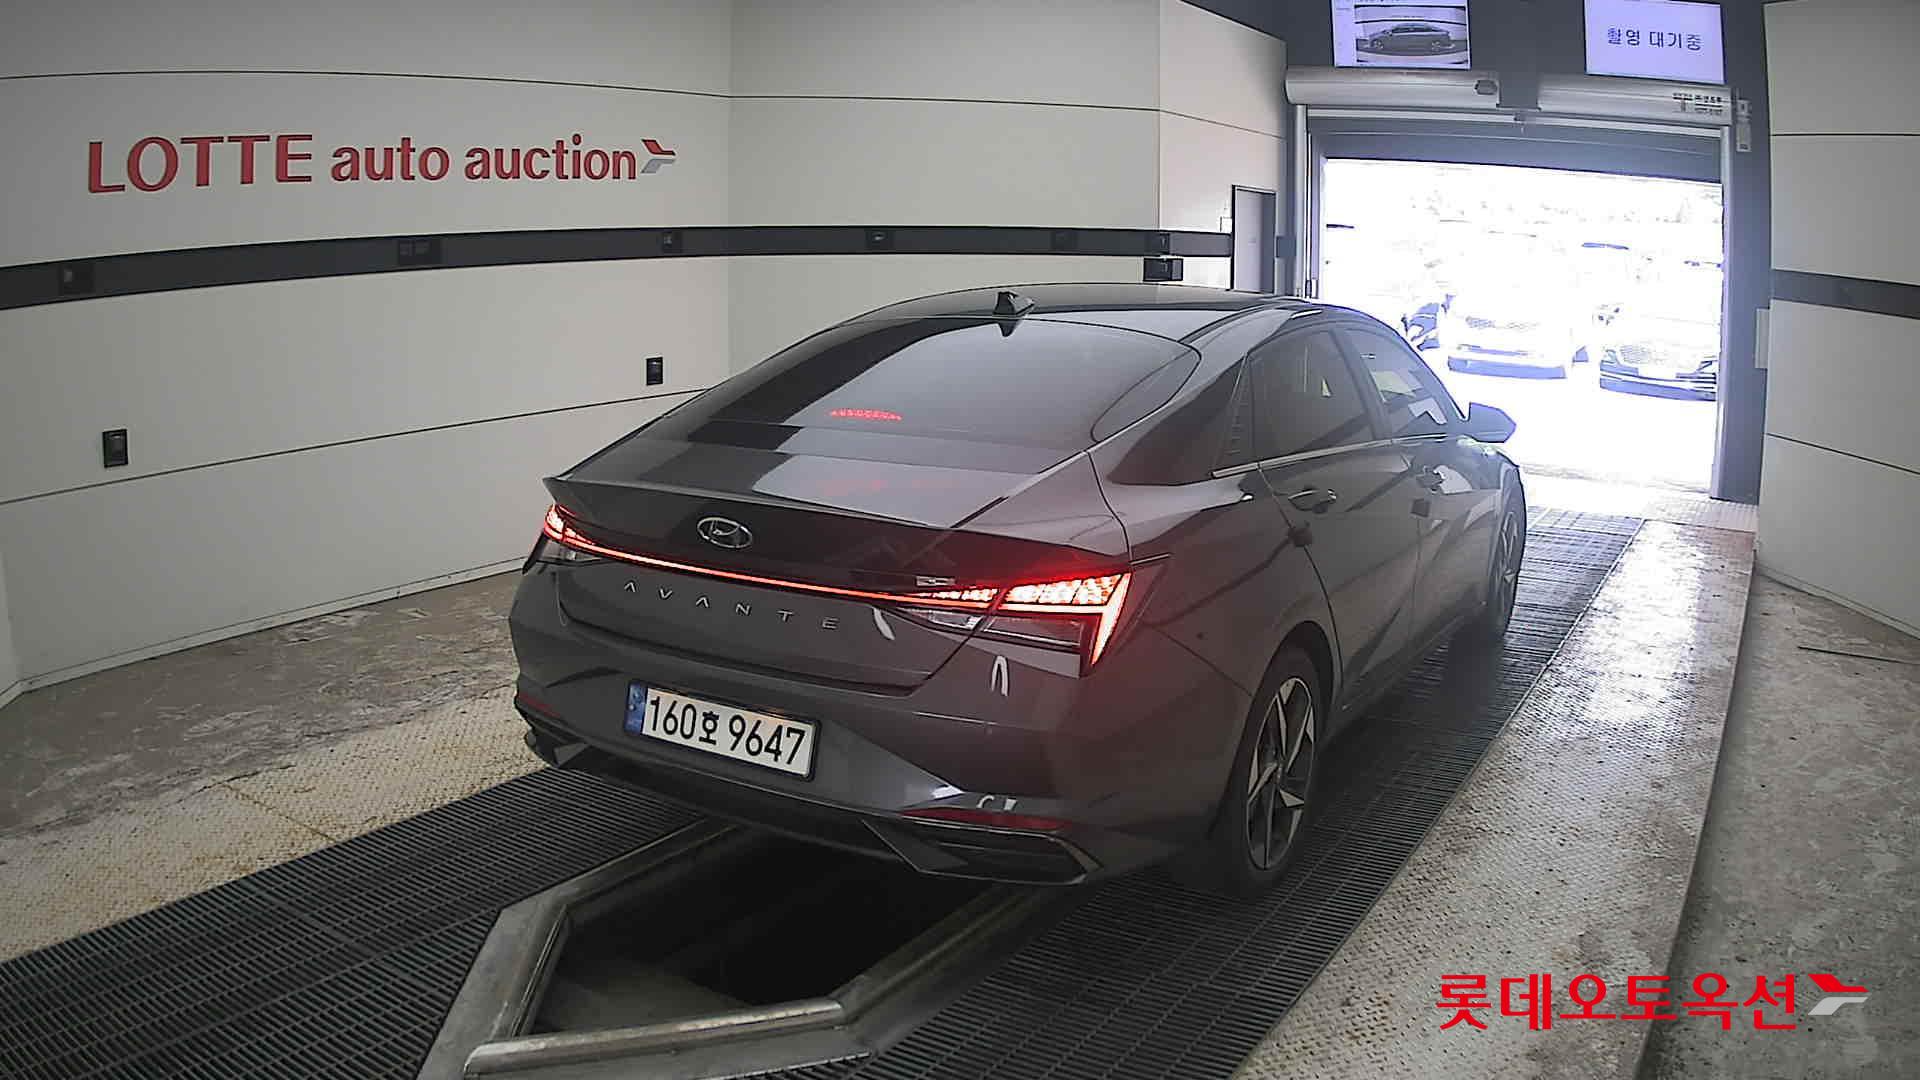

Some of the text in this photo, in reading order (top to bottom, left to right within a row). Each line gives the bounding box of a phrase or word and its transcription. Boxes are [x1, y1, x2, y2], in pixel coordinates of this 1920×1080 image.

[88, 134, 637, 193] LOTTE auto auction
[624, 581, 839, 630] AVANTE
[650, 696, 806, 765] 160호 9647
